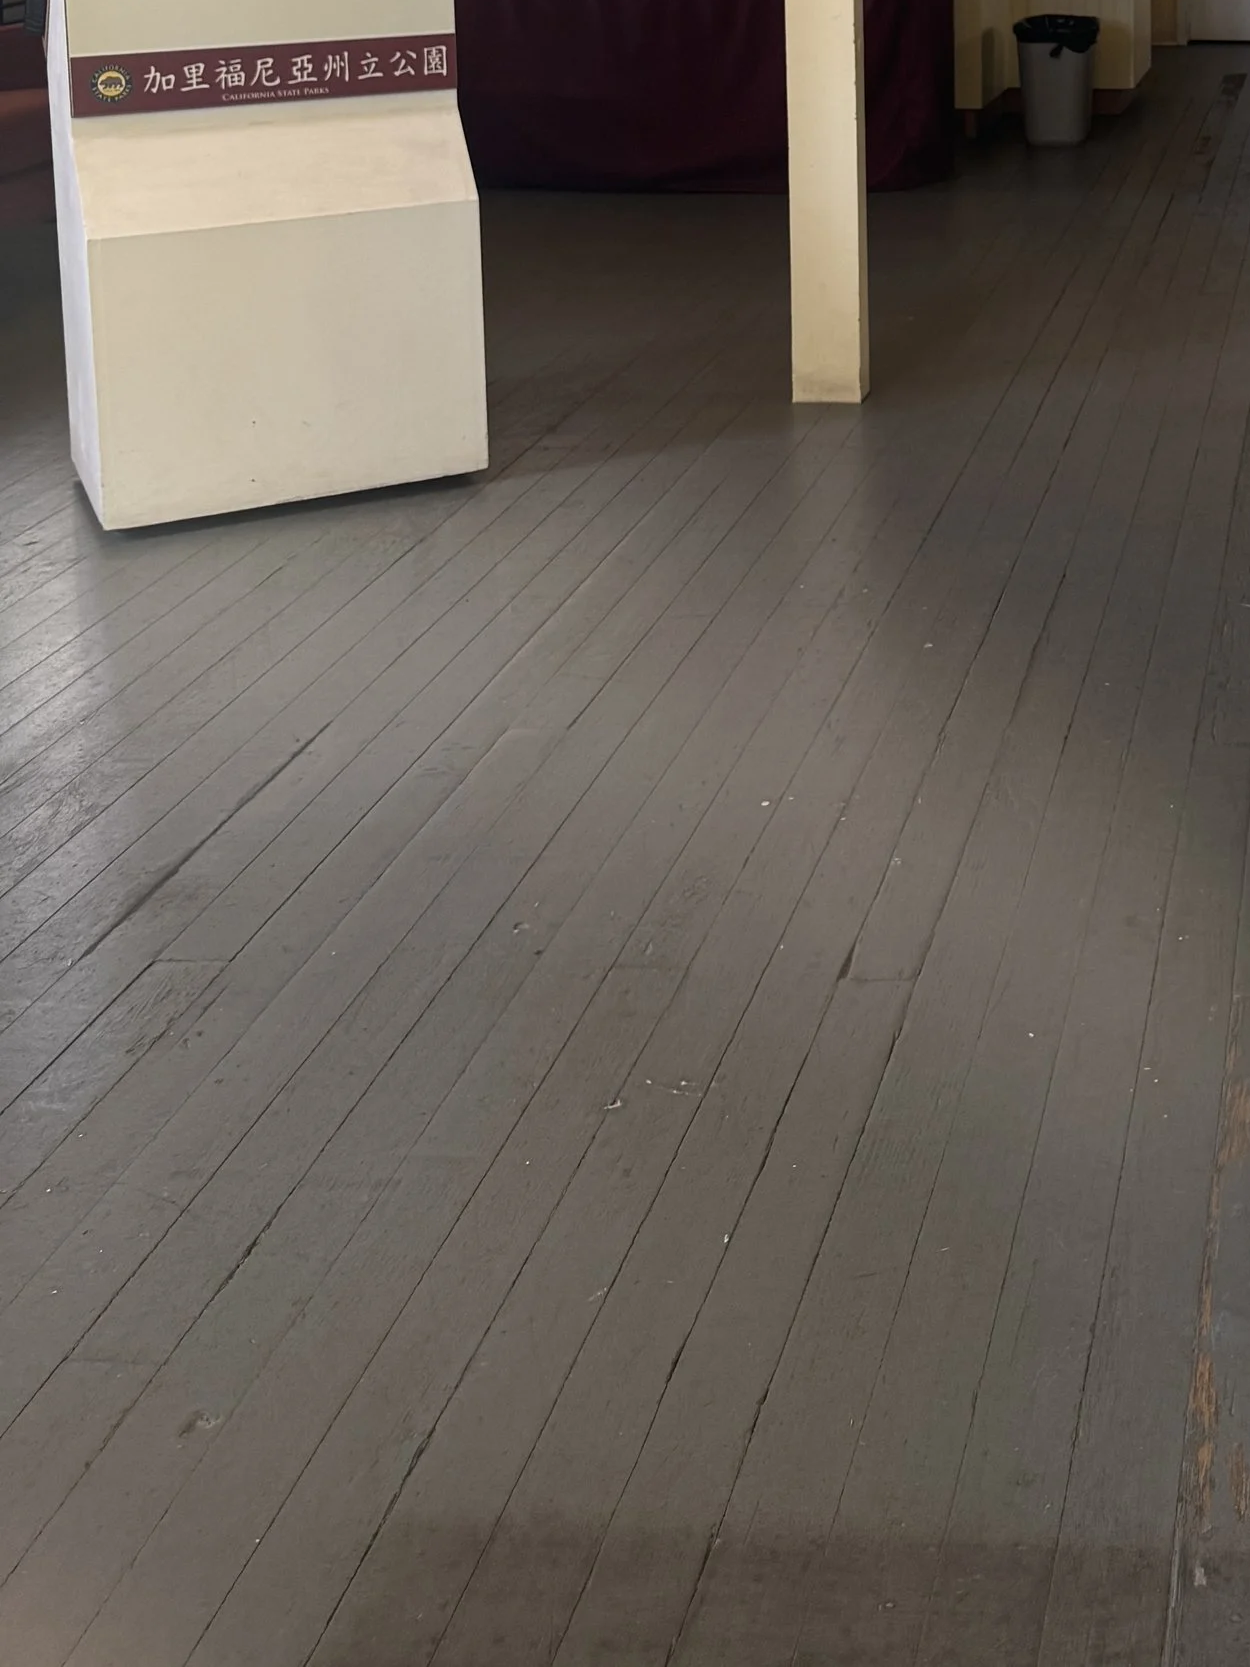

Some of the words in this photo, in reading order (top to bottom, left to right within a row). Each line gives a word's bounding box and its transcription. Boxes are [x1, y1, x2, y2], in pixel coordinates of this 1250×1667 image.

[221, 90, 276, 101] CALIFORNIA
[277, 88, 301, 99] STATE
[302, 86, 329, 96] PARKS
